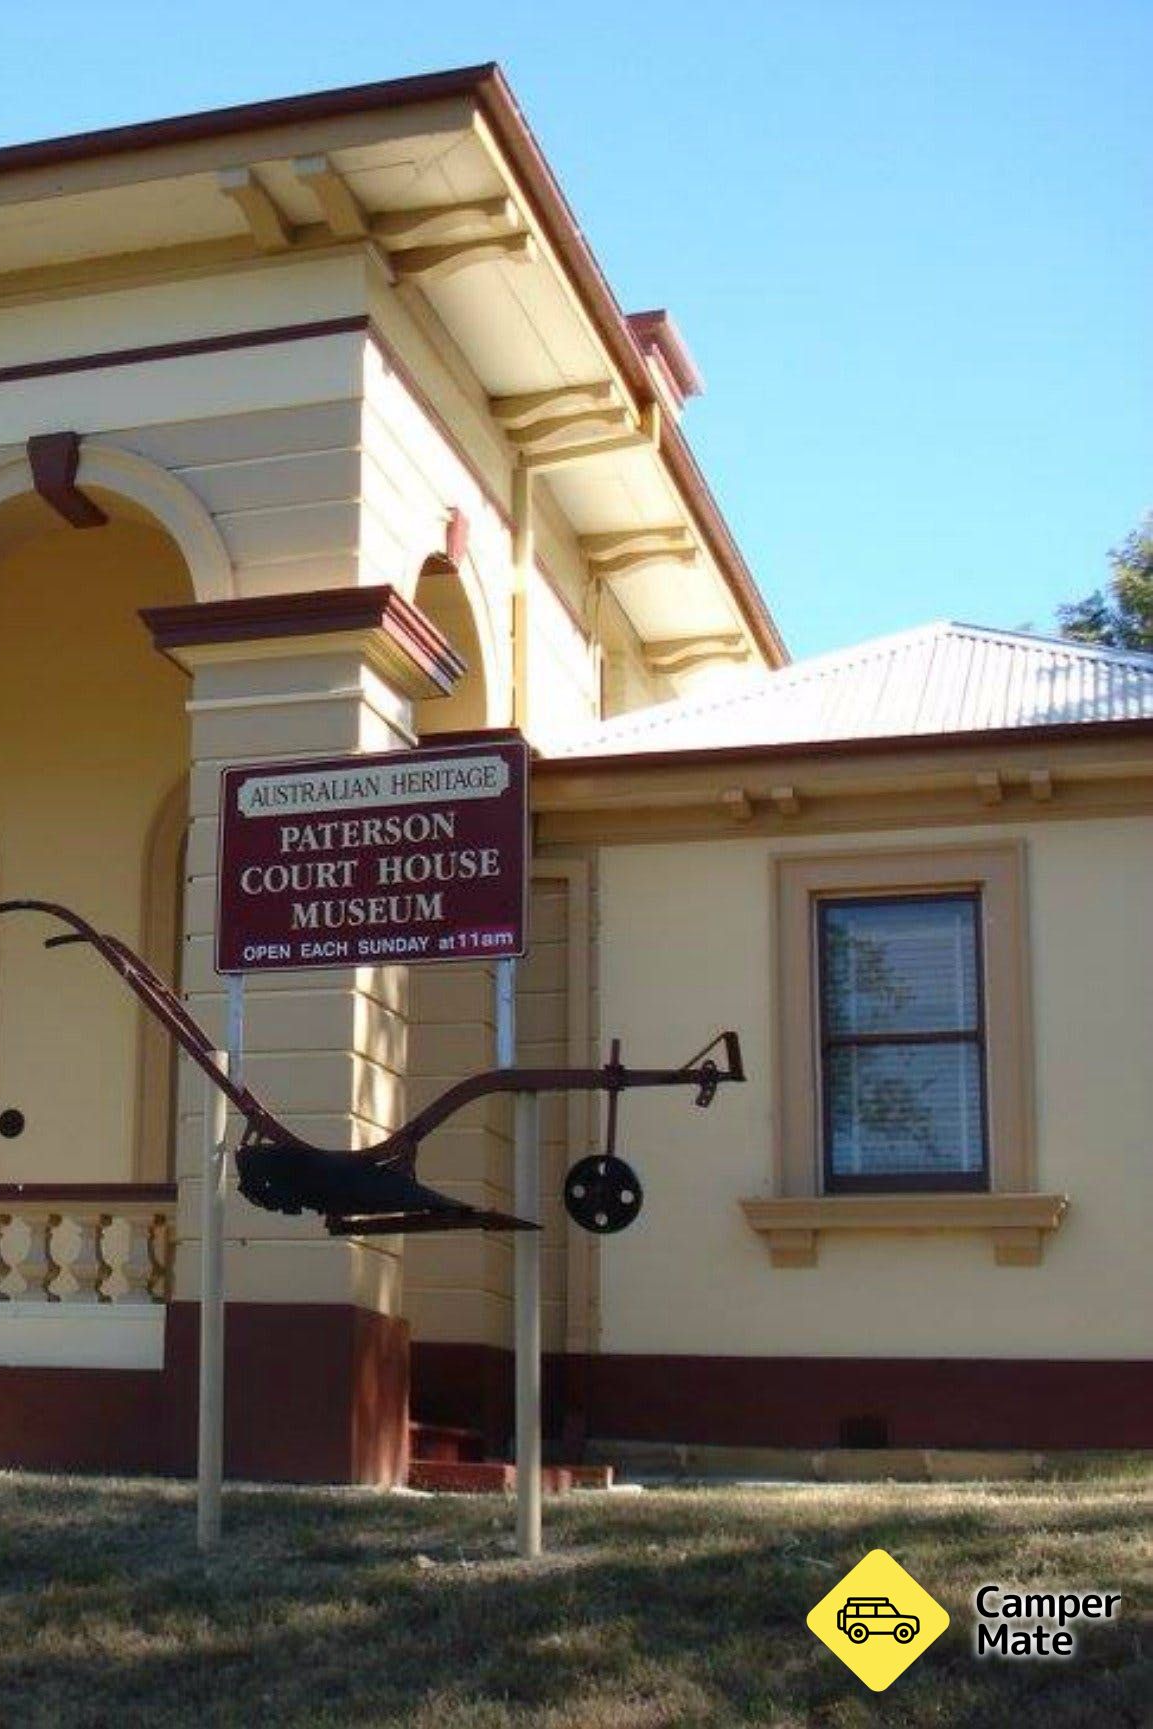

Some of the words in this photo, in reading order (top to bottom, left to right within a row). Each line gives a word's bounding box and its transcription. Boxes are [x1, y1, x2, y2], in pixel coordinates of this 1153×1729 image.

[250, 776, 380, 807] AUSTRALIAN
[391, 766, 497, 795] HERITAGE
[281, 812, 455, 852] PATERSON
[241, 860, 359, 895] COURT
[377, 849, 500, 885] HOUSE
[291, 893, 444, 930] MUSEUM
[243, 945, 291, 961] OPEN
[300, 940, 348, 957] EACH
[357, 936, 431, 954] SUNDAY
